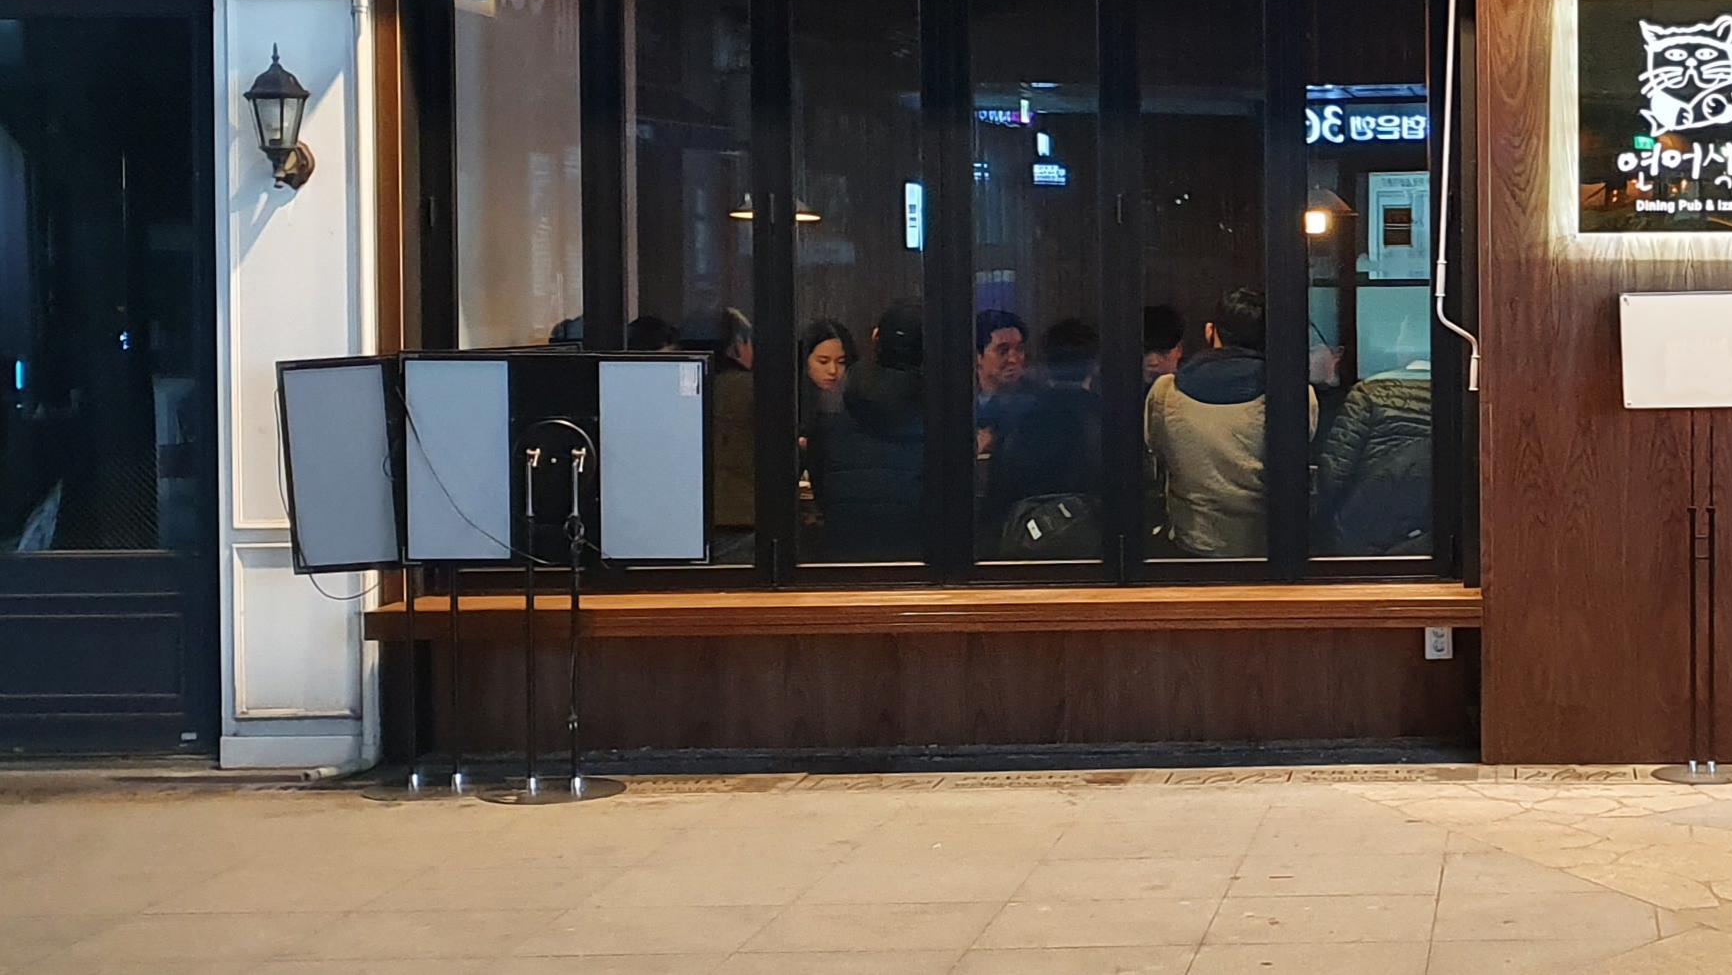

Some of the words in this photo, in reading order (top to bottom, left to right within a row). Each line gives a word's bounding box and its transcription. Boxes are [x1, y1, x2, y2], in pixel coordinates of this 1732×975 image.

[1636, 199, 1675, 214] Dining
[1678, 199, 1702, 211] Pub
[1705, 199, 1715, 211] &
